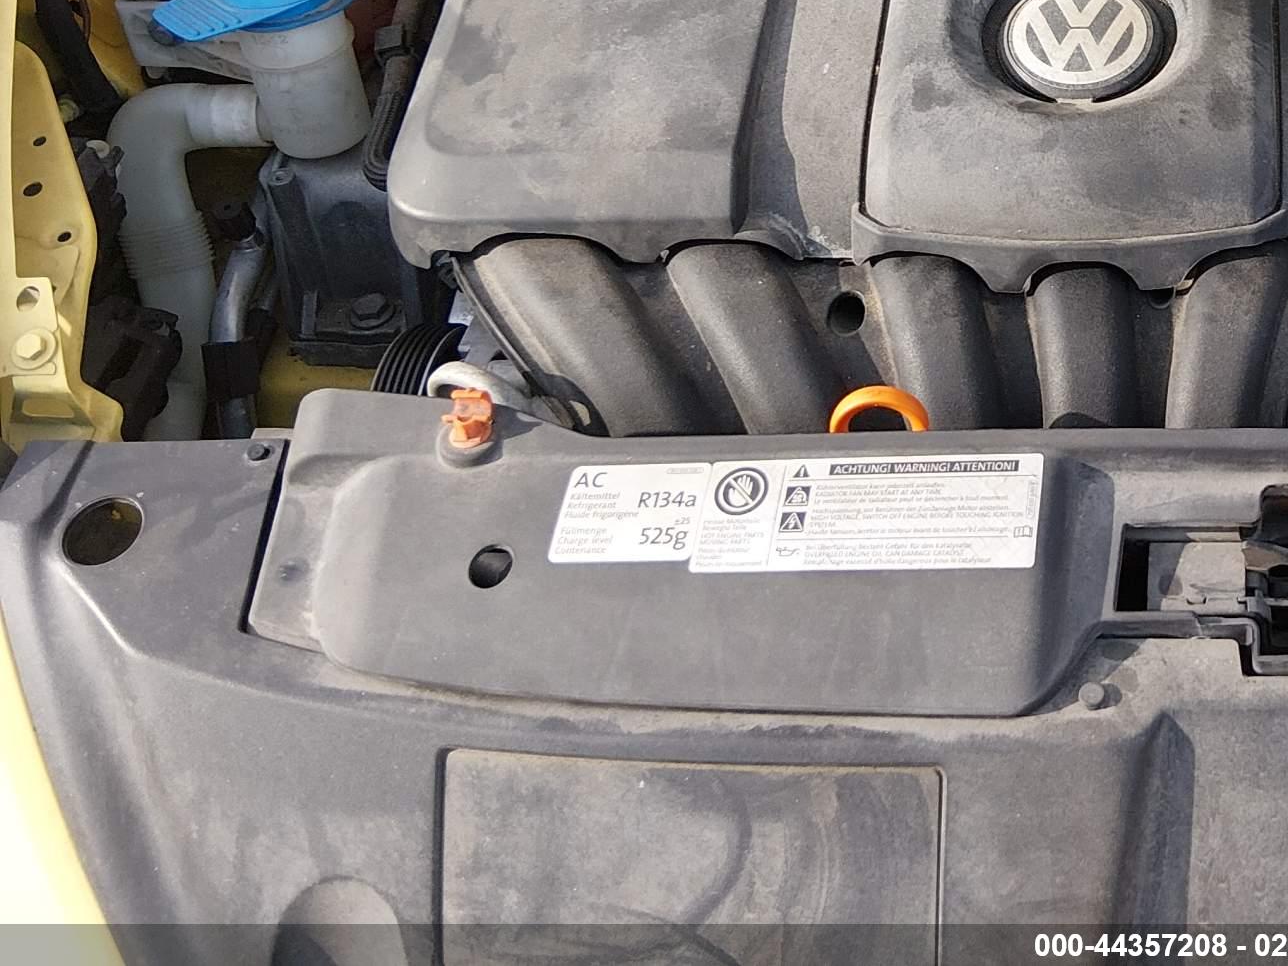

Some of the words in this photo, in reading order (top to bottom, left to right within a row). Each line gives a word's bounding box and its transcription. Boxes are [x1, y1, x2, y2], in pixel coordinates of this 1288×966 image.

[833, 464, 891, 474] ACHTUNG!
[894, 463, 951, 473] WARNING!
[952, 462, 1017, 472] ATTENTION!
[574, 472, 608, 488] AC
[638, 491, 697, 508] R134a
[638, 527, 688, 551] 525g
